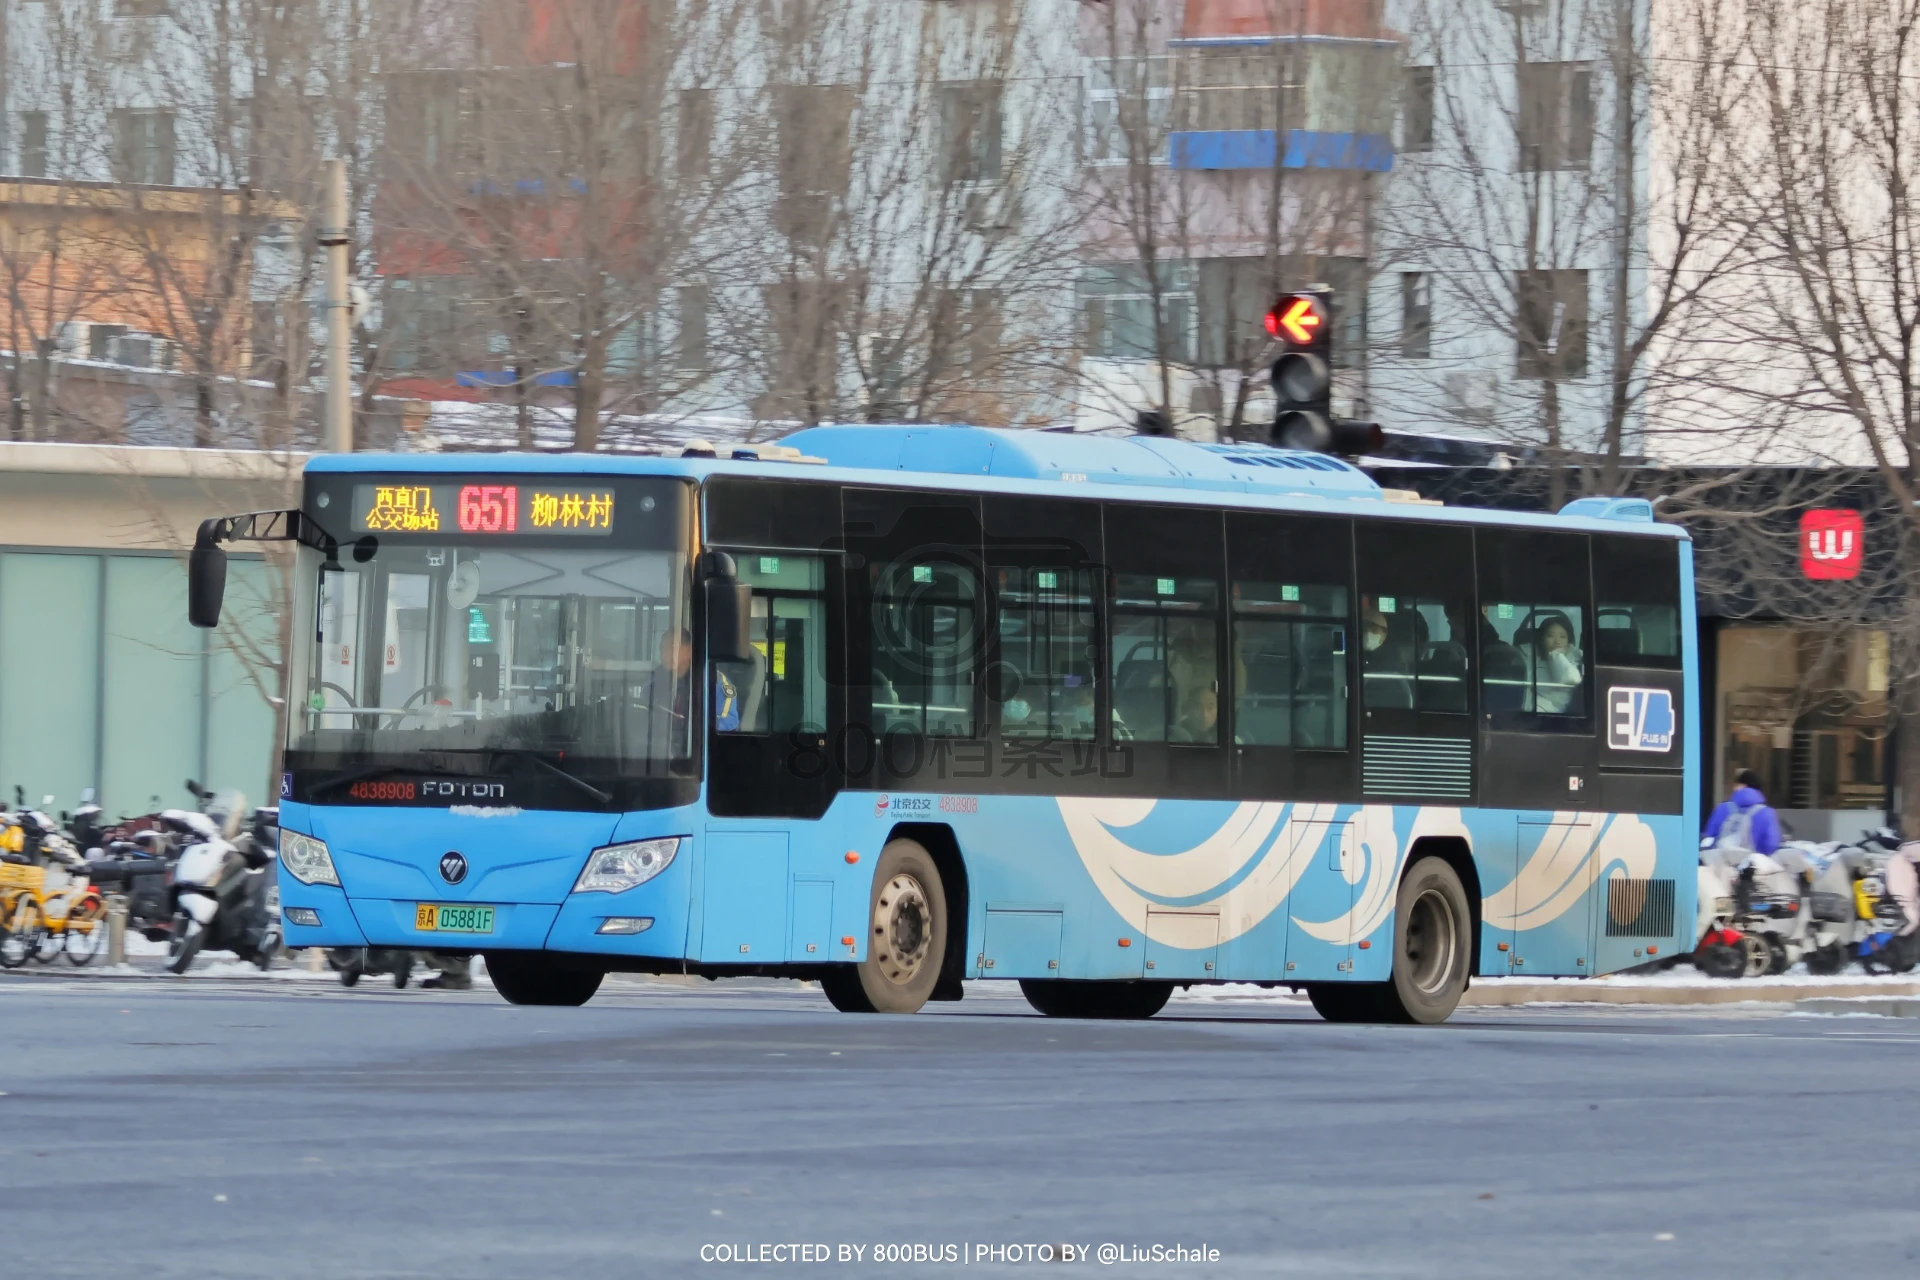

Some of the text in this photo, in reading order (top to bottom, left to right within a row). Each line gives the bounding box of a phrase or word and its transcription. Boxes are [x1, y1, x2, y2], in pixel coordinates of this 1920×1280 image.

[374, 486, 431, 509] 西直门
[458, 485, 518, 532] 651
[531, 493, 613, 528] 柳林村
[365, 508, 440, 531] 公交场站
[349, 782, 416, 800] 4838908
[422, 781, 505, 798] FOTON
[892, 798, 932, 810] 北京公交
[939, 796, 978, 814] 4838908
